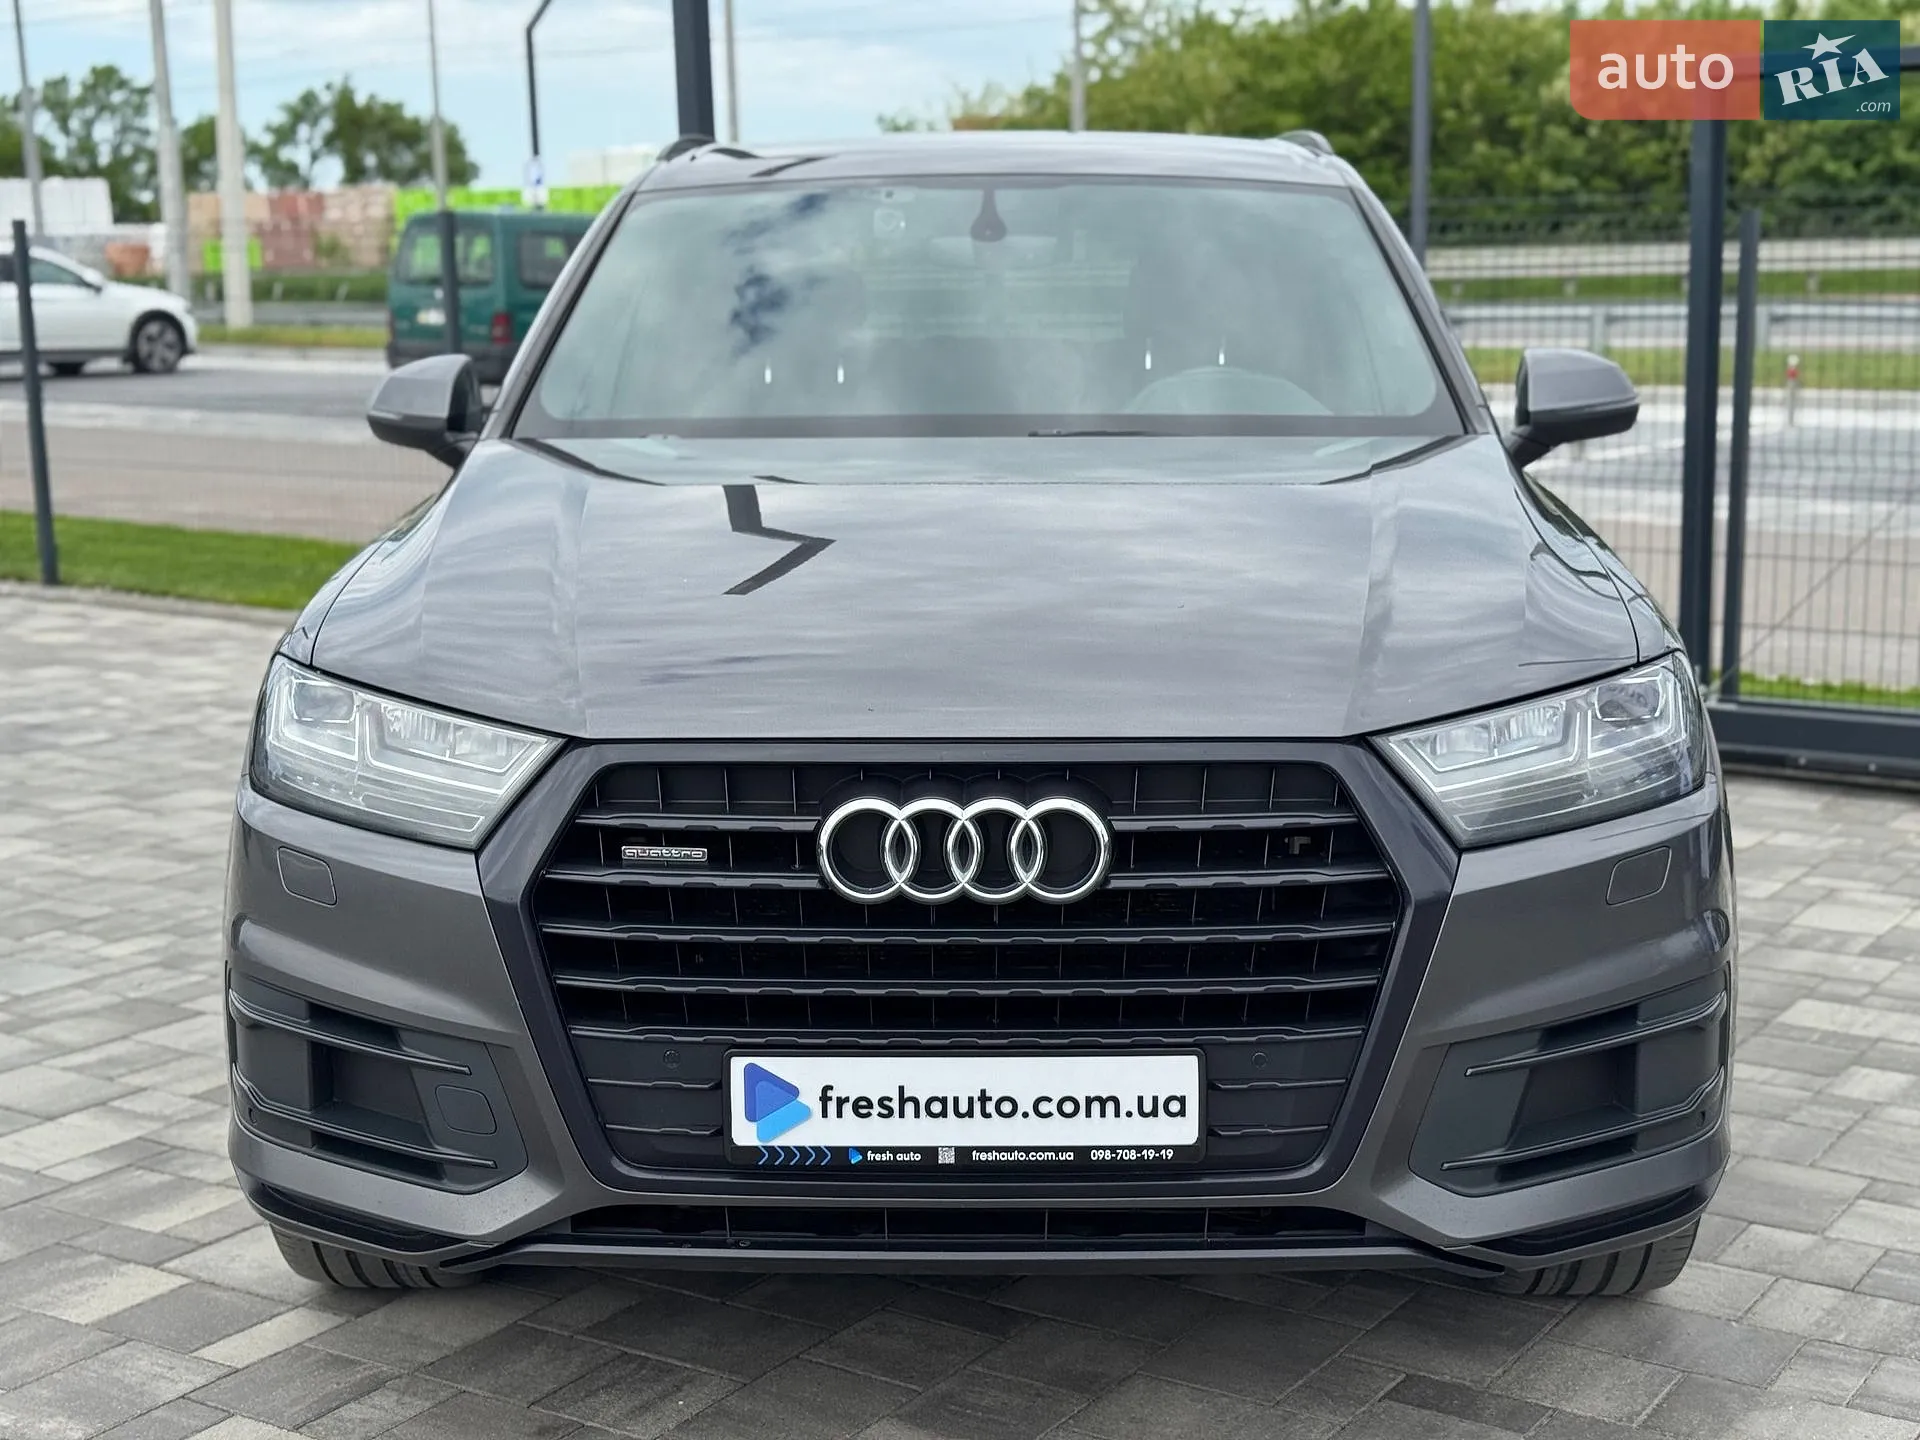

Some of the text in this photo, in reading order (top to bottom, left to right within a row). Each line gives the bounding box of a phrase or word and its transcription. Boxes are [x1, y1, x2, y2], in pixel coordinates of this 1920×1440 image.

[624, 847, 704, 860] quattro
[819, 1085, 1187, 1120] freshauto.com.ua
[866, 1150, 922, 1163] fresh auto
[972, 1149, 1074, 1162] freshauto.com.ua
[1090, 1149, 1174, 1161] 098-708-19-19
